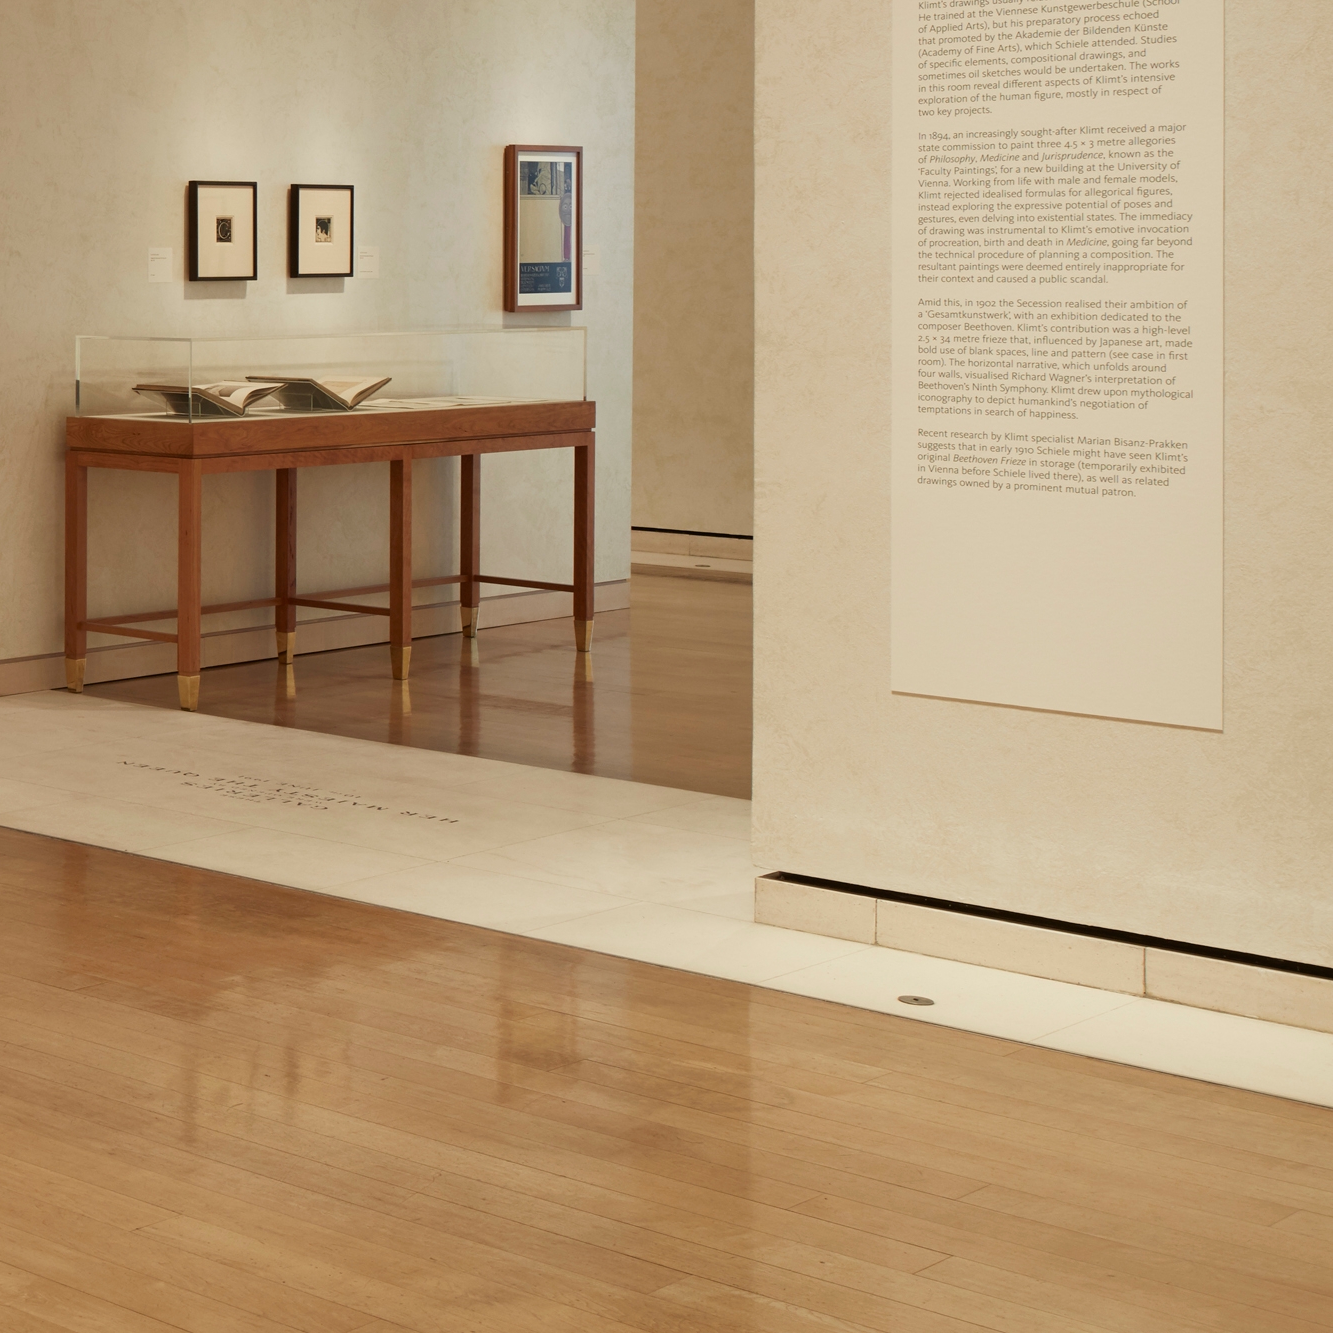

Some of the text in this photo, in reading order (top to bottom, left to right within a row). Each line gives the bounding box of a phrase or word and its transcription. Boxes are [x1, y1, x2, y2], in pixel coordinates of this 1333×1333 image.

[919, 12, 931, 21] He
[934, 10, 965, 20] trained
[967, 9, 975, 17] at
[979, 8, 993, 17] the
[996, 7, 1038, 15] Viennese
[919, 21, 1168, 45] that promoted by the Akademie der Bildenden Künste
[918, 47, 962, 58] (Academy
[964, 45, 974, 54] of
[976, 45, 995, 53] Fine
[1025, 40, 1052, 50] which
[1055, 39, 1089, 48] Schiele
[1141, 34, 1177, 44] Studies
[918, 71, 966, 80] sometimes
[969, 69, 979, 77] oil
[982, 67, 1021, 77] sketches
[1024, 65, 1051, 75] would
[1055, 65, 1066, 73] be
[1129, 60, 1147, 69] The
[1150, 59, 1180, 68] works
[919, 131, 926, 139] In
[966, 128, 1018, 139] increasingly
[1021, 126, 1077, 138] sought-after
[1080, 125, 1104, 134] Klimt
[1107, 123, 1147, 133] received
[1158, 123, 1187, 133] major
[918, 155, 927, 163] of
[980, 153, 1020, 161] Medicine
[1022, 152, 1039, 160] and
[1109, 149, 1141, 158] known
[1158, 148, 1174, 156] the
[919, 190, 941, 198] Klimt
[944, 189, 979, 200] rejected
[983, 189, 1022, 197] idealised
[1026, 188, 1066, 197] formulas
[1069, 188, 1081, 196] for
[1085, 186, 1133, 198] allegorical
[919, 198, 1173, 212] instead exploring the expressive potential of poses and
[918, 226, 927, 234] of
[929, 226, 965, 236] drawing
[987, 225, 1045, 233] instrumental
[1049, 225, 1059, 233] to
[1095, 224, 1134, 233] emotive
[1138, 224, 1189, 232] invocation
[918, 250, 933, 258] the
[935, 250, 975, 258] technical
[978, 250, 1024, 260] procedure
[1027, 250, 1037, 258] of
[1039, 250, 1079, 260] planning
[1156, 249, 1174, 258] The
[918, 273, 938, 281] their
[941, 273, 974, 281] context
[977, 274, 993, 282] and
[996, 274, 1028, 282] caused
[1039, 274, 1067, 284] public
[918, 323, 961, 331] composer
[1050, 323, 1109, 332] contribution
[1143, 325, 1190, 336] high-level
[949, 357, 965, 366] The
[968, 358, 1013, 367] horizontal
[1062, 360, 1090, 369] which
[1094, 361, 1129, 370] unfolds
[1132, 363, 1167, 371] around
[973, 382, 997, 391] Ninth
[1052, 385, 1075, 393] Klimt
[1078, 385, 1101, 394] drew
[1104, 389, 1127, 397] upon
[1131, 388, 1193, 400] mythological
[918, 404, 971, 415] temptations
[984, 408, 1015, 416] search
[1017, 408, 1027, 416] of
[918, 428, 1188, 449] Recent research by Klimt specialist Marian Bisanz-Prakken
[917, 475, 957, 487] drawings
[959, 479, 989, 487] owned
[993, 479, 1003, 490] by
[1014, 482, 1062, 492] prominent
[1066, 485, 1099, 494] mutual
[116, 760, 200, 778] QUEEN
[208, 777, 259, 788] THE
[179, 781, 329, 811] GALLERIES
[399, 810, 460, 824] HER
